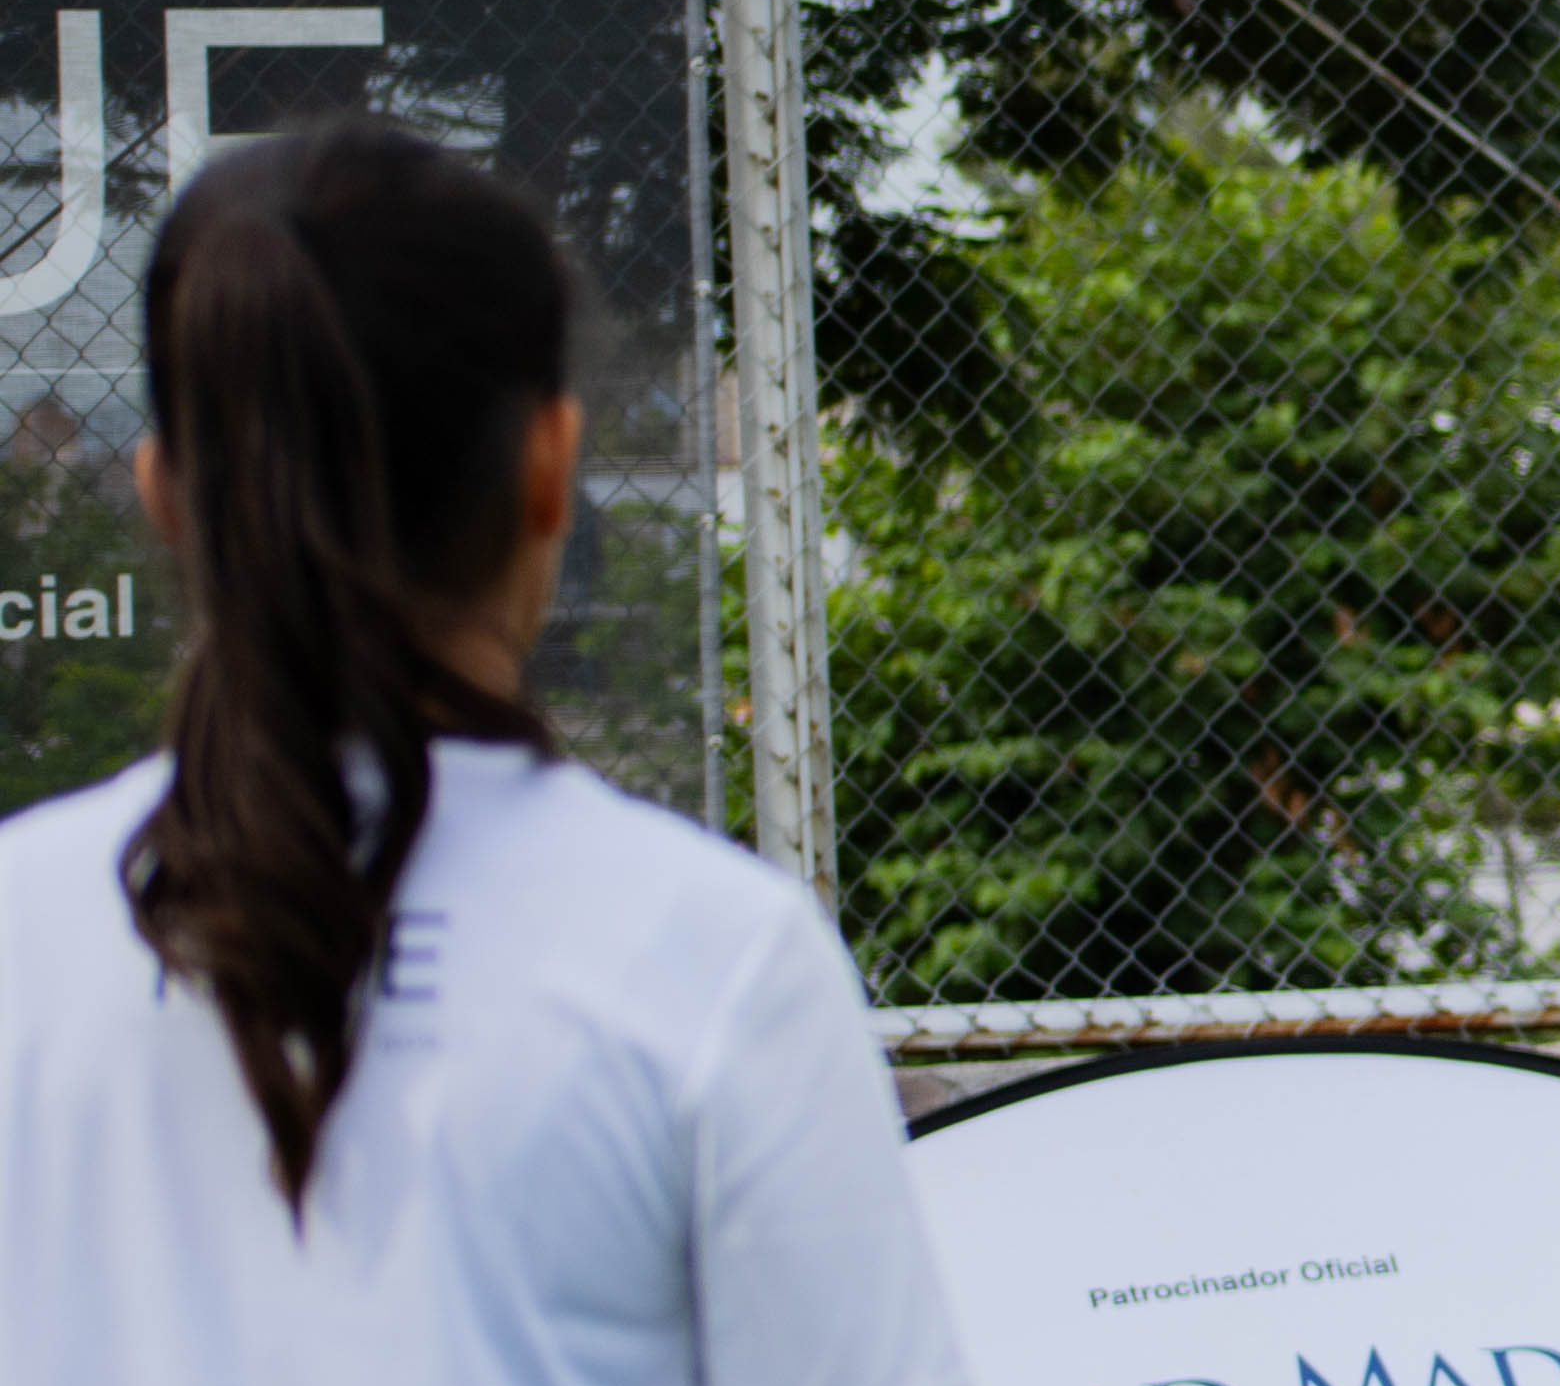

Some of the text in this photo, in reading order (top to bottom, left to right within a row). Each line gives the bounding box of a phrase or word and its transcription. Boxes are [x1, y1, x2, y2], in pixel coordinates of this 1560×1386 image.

[0, 573, 133, 640] cial
[1089, 1254, 1398, 1309] Patrocinador Oficial
